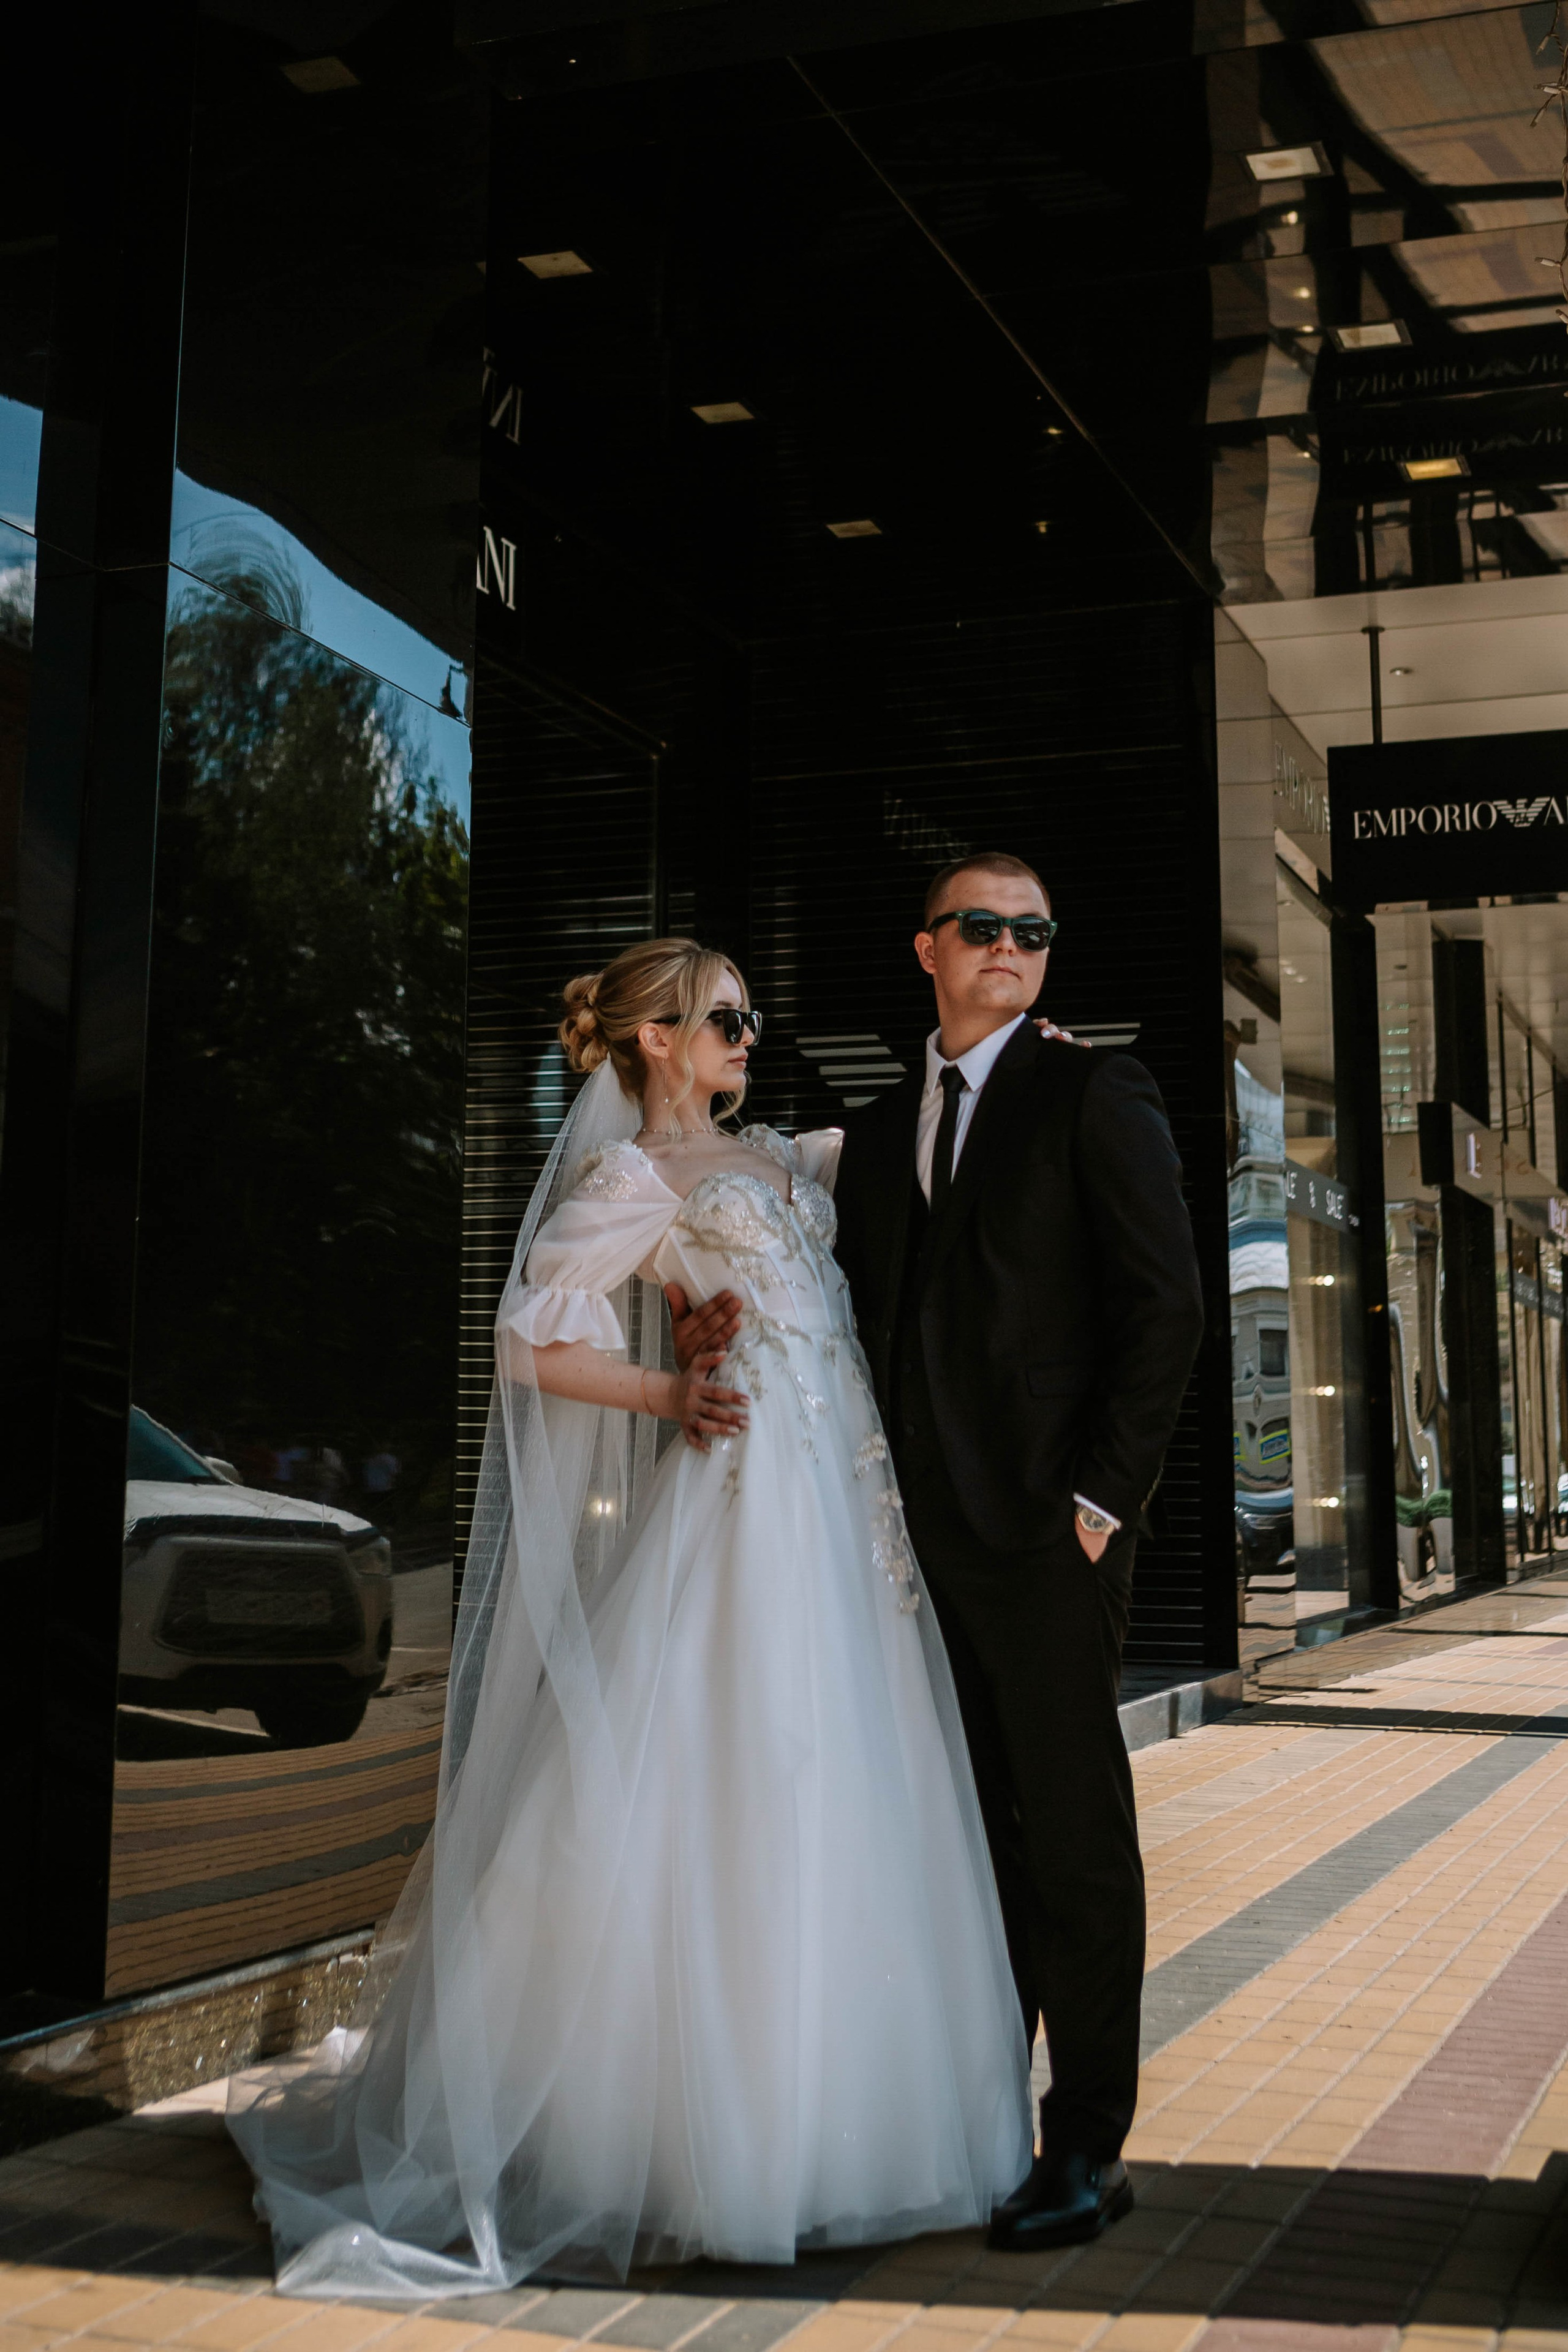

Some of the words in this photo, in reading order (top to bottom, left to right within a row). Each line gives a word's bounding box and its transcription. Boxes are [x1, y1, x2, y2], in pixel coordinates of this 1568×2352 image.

[477, 525, 517, 611] NI
[1354, 800, 1498, 840] EMPORIO
[1544, 795, 1568, 826] A
